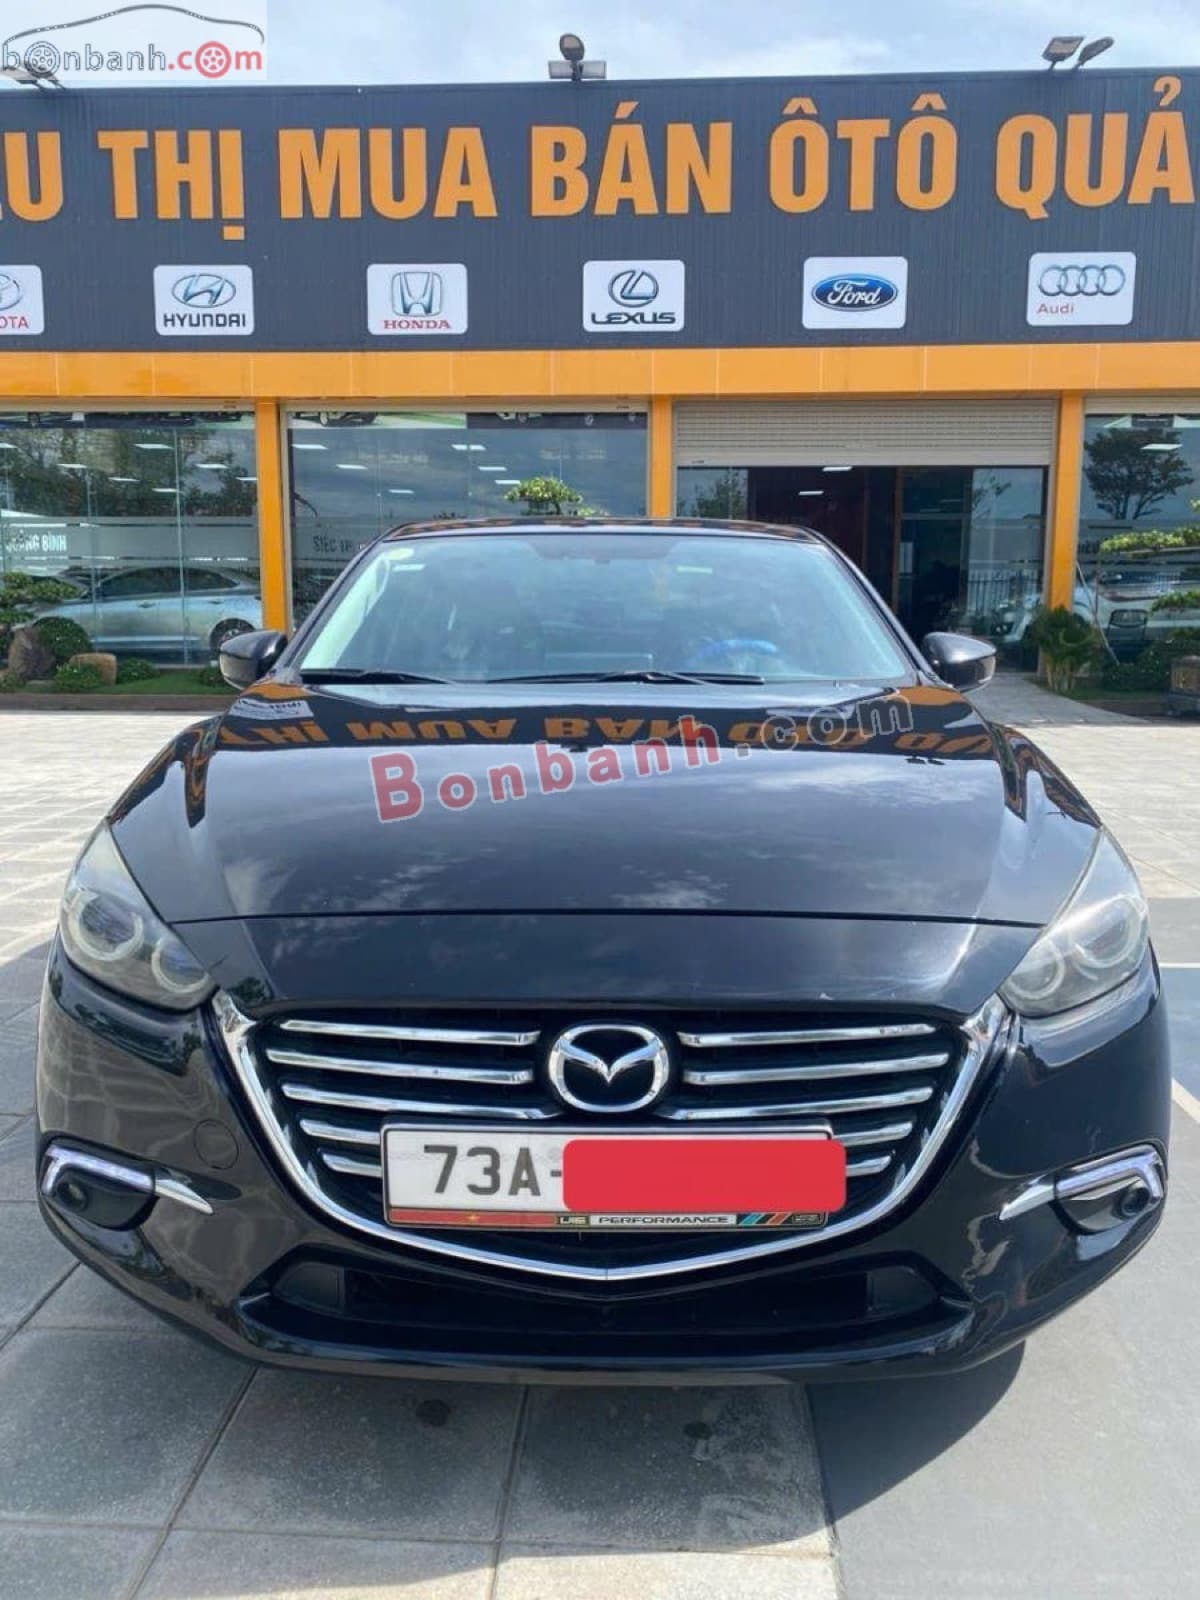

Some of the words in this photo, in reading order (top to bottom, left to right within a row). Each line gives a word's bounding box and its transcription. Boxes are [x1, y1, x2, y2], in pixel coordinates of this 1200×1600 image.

[0, 131, 63, 222] U
[97, 129, 245, 241] THỊ
[278, 127, 498, 219] MUA
[530, 101, 733, 217] BÁN
[768, 92, 958, 212] ÔTÔ
[994, 76, 1196, 220] QUẢ
[827, 279, 882, 305] Ford
[1037, 303, 1074, 315] Audi
[163, 313, 246, 328] HYUNDAI
[383, 319, 451, 330] HONDA
[591, 312, 676, 325] LEXUS
[599, 1215, 728, 1225] PERFORMANCE
